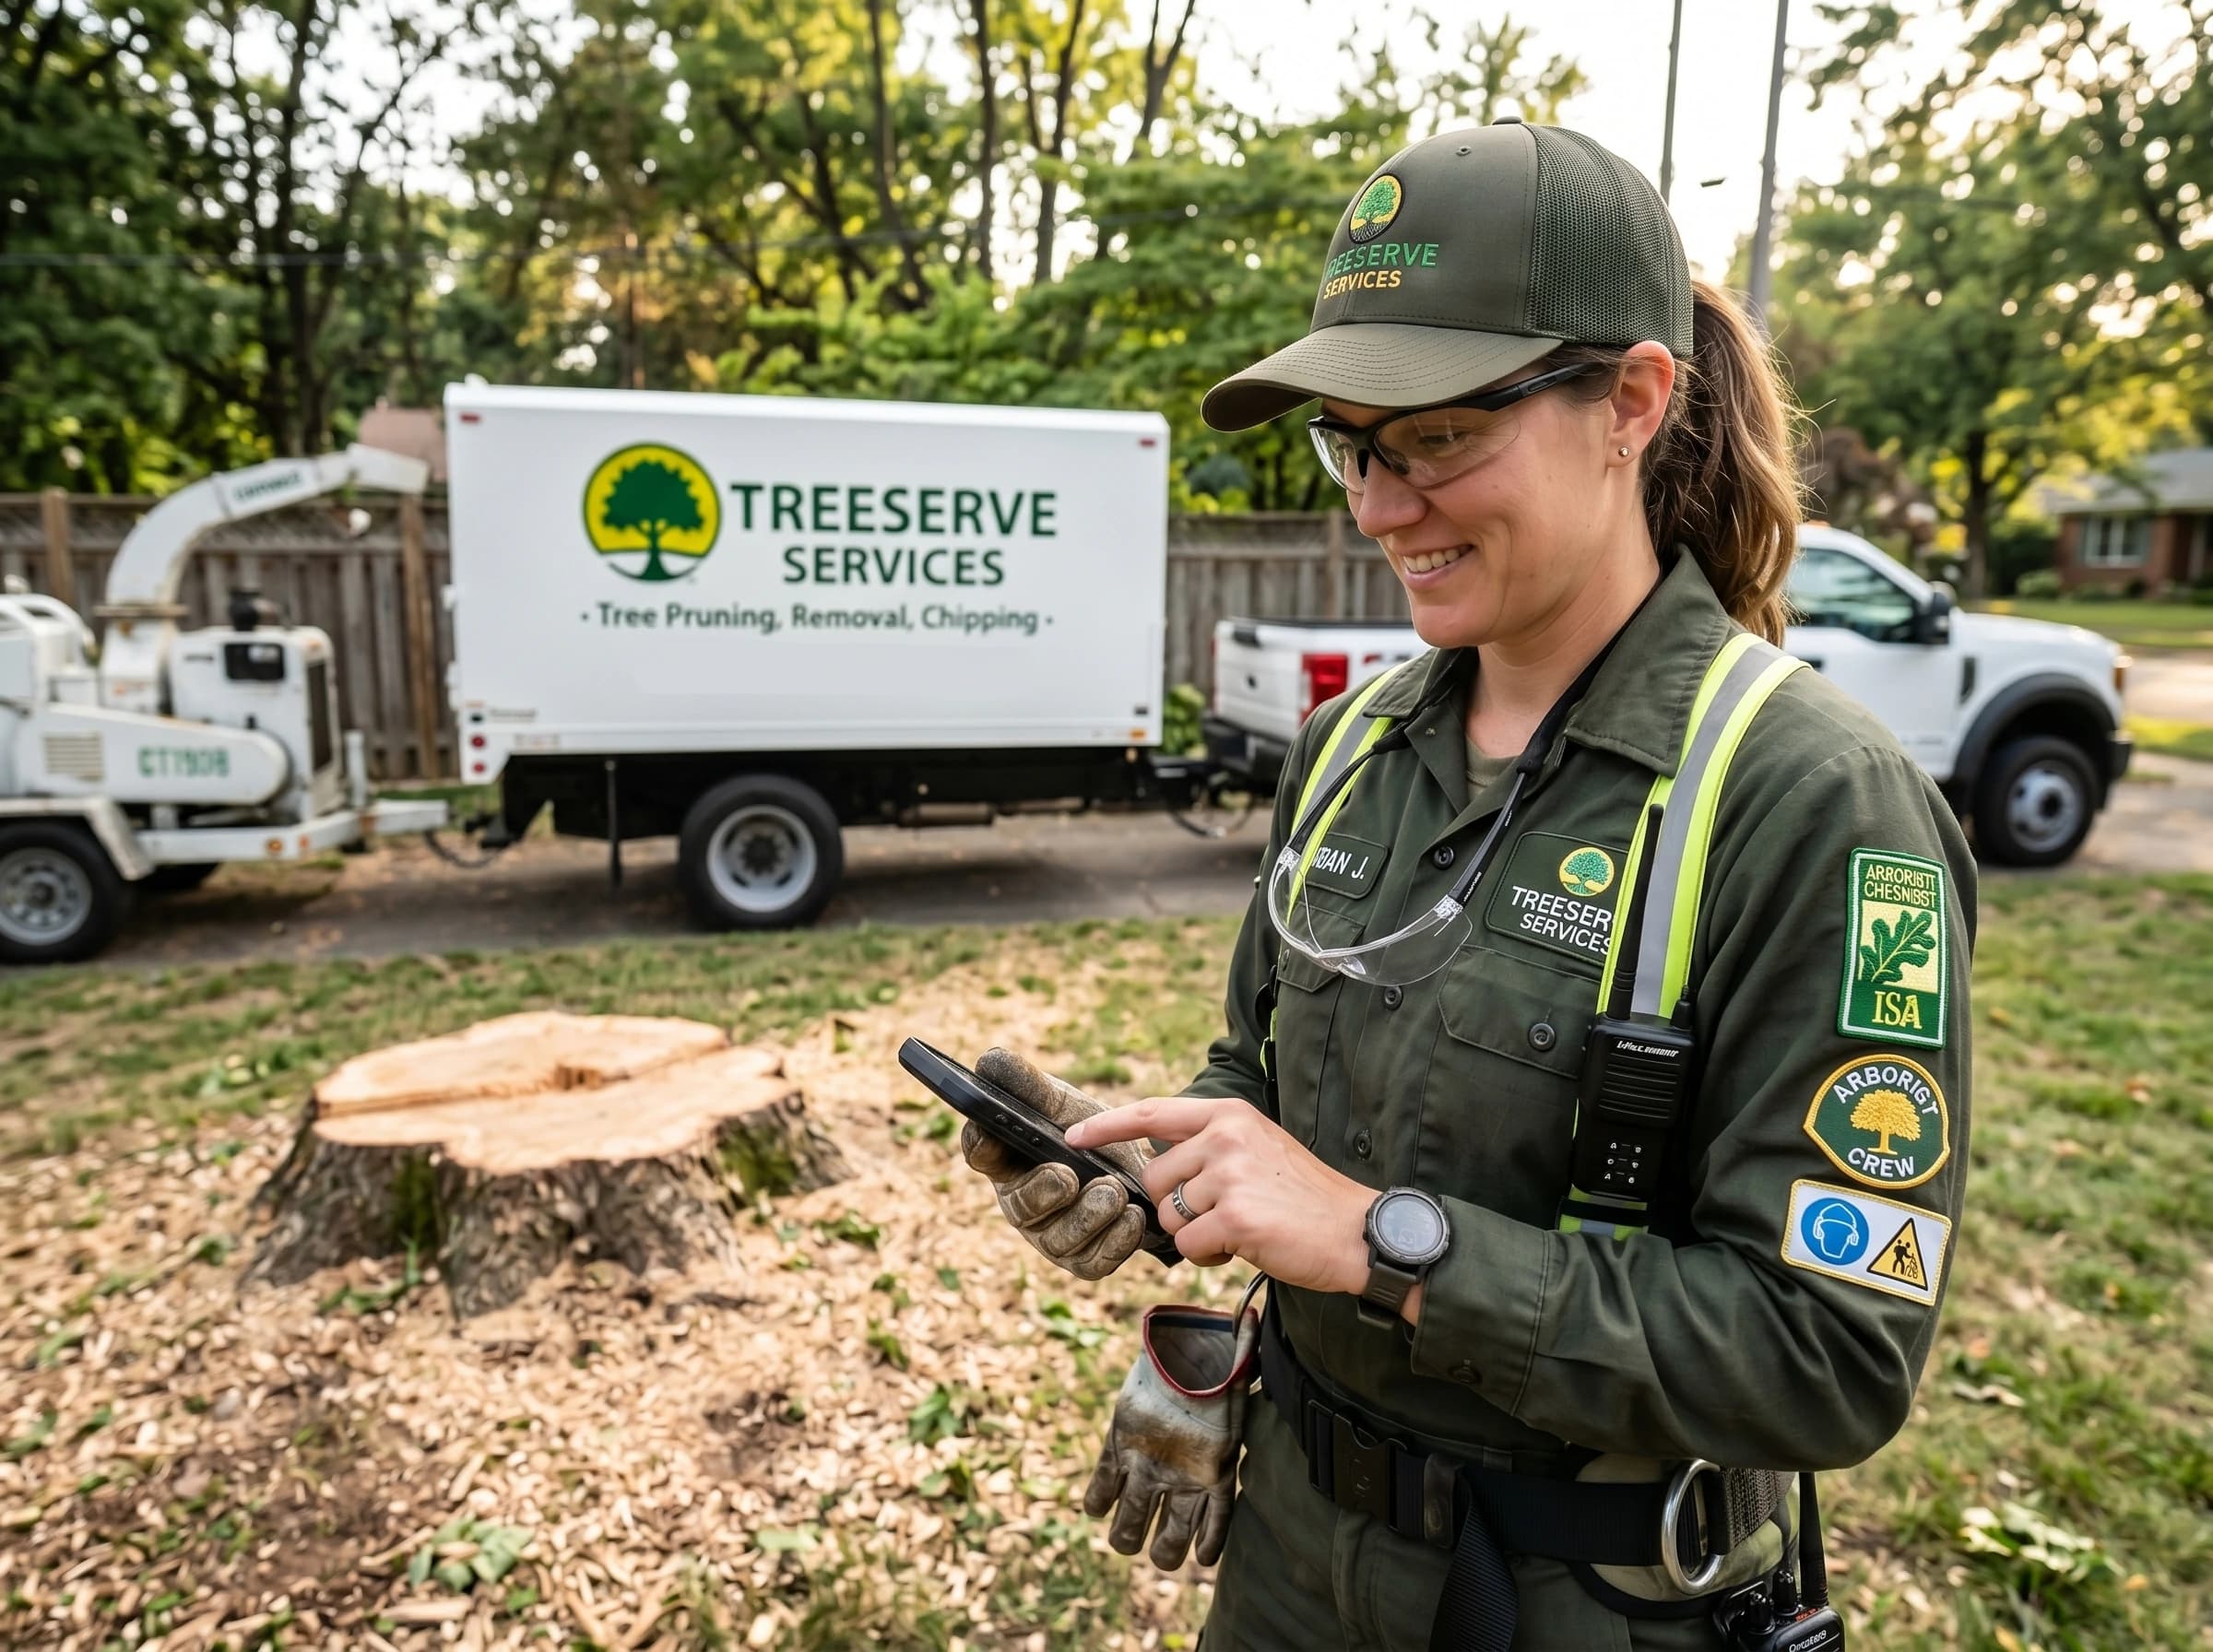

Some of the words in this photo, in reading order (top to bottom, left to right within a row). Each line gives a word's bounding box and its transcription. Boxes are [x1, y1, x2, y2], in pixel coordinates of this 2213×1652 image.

[1324, 242, 1439, 280] REESERVE
[1323, 269, 1402, 300] SERVICES
[729, 483, 1058, 537] TREESERVE
[782, 546, 1005, 586] SERVICES
[596, 600, 658, 629] Tree
[665, 601, 784, 637] Pruning,
[790, 603, 915, 631] Removal,
[920, 604, 1039, 636] Chipping
[1351, 856, 1369, 879] J.
[1511, 885, 1613, 932] TREESER
[1871, 990, 1923, 1030] ISA
[1847, 1147, 1915, 1178] CREW
